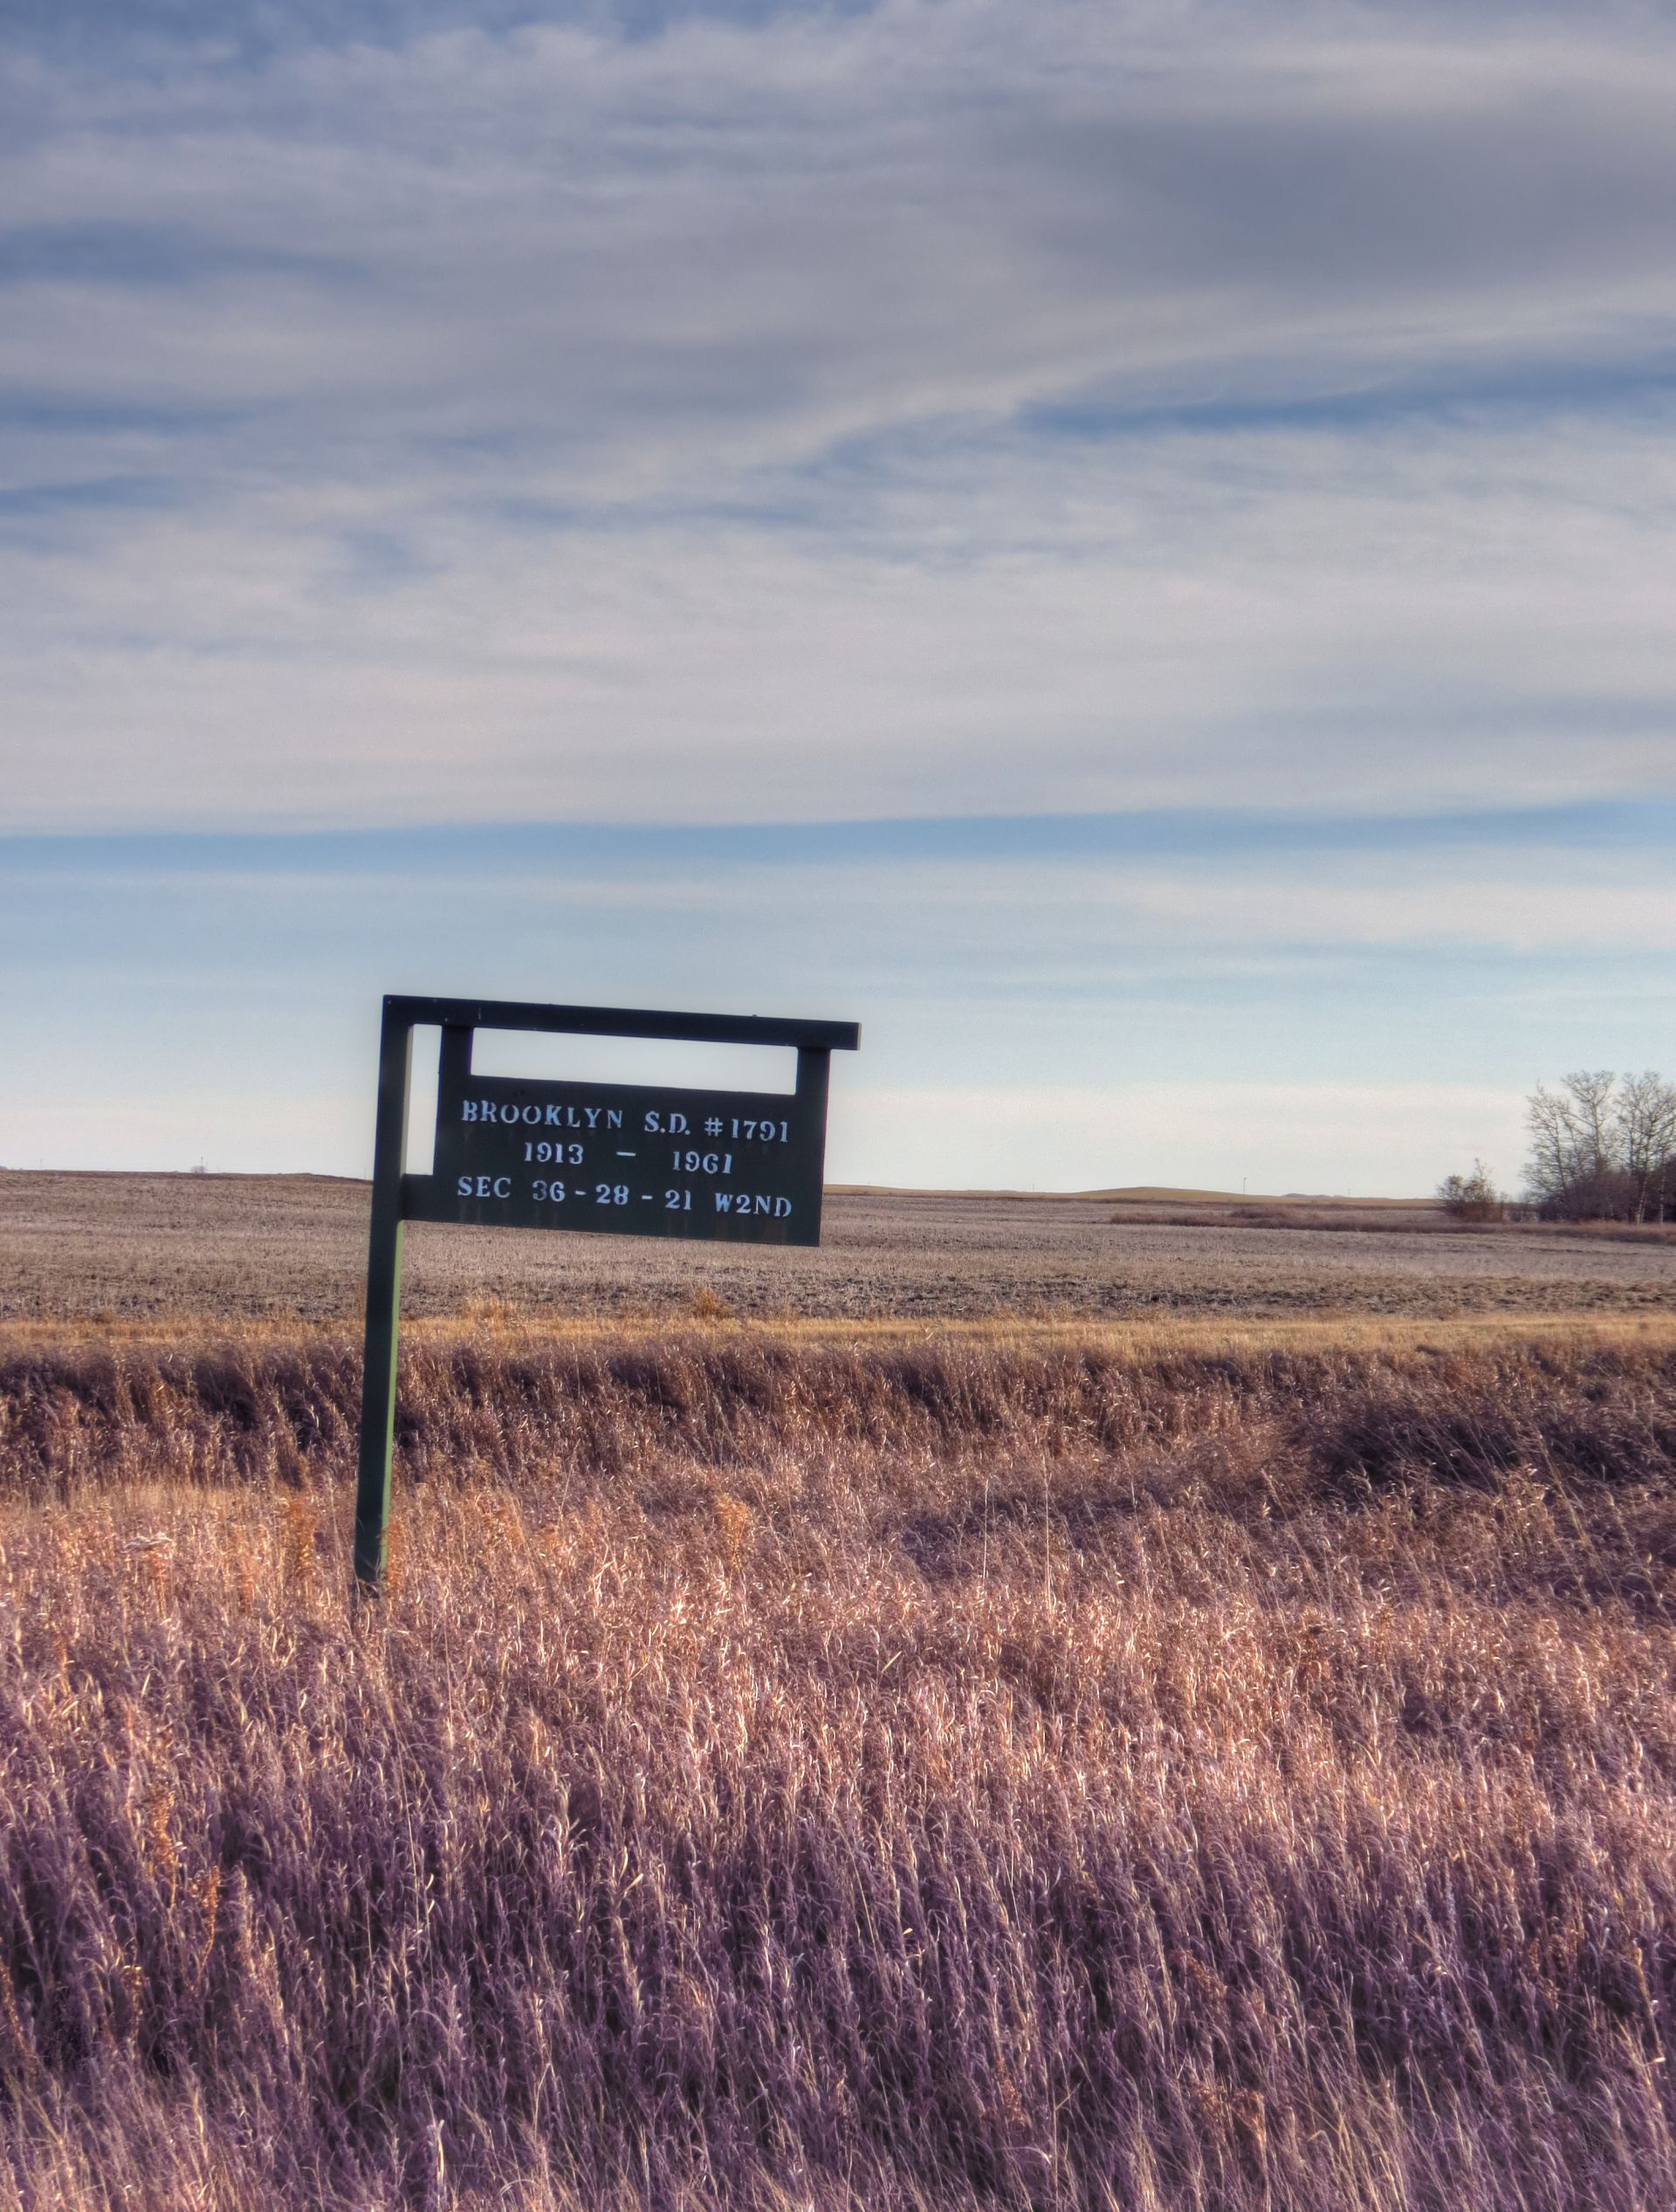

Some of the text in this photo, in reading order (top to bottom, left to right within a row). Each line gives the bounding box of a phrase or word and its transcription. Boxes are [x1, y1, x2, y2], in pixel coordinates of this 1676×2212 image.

[462, 1101, 787, 1142] BROOKLYN S.D. #1791
[525, 1143, 583, 1164] 1913
[674, 1151, 732, 1173] 1961
[457, 1176, 511, 1198] SEC
[715, 1193, 791, 1217] W2ND
